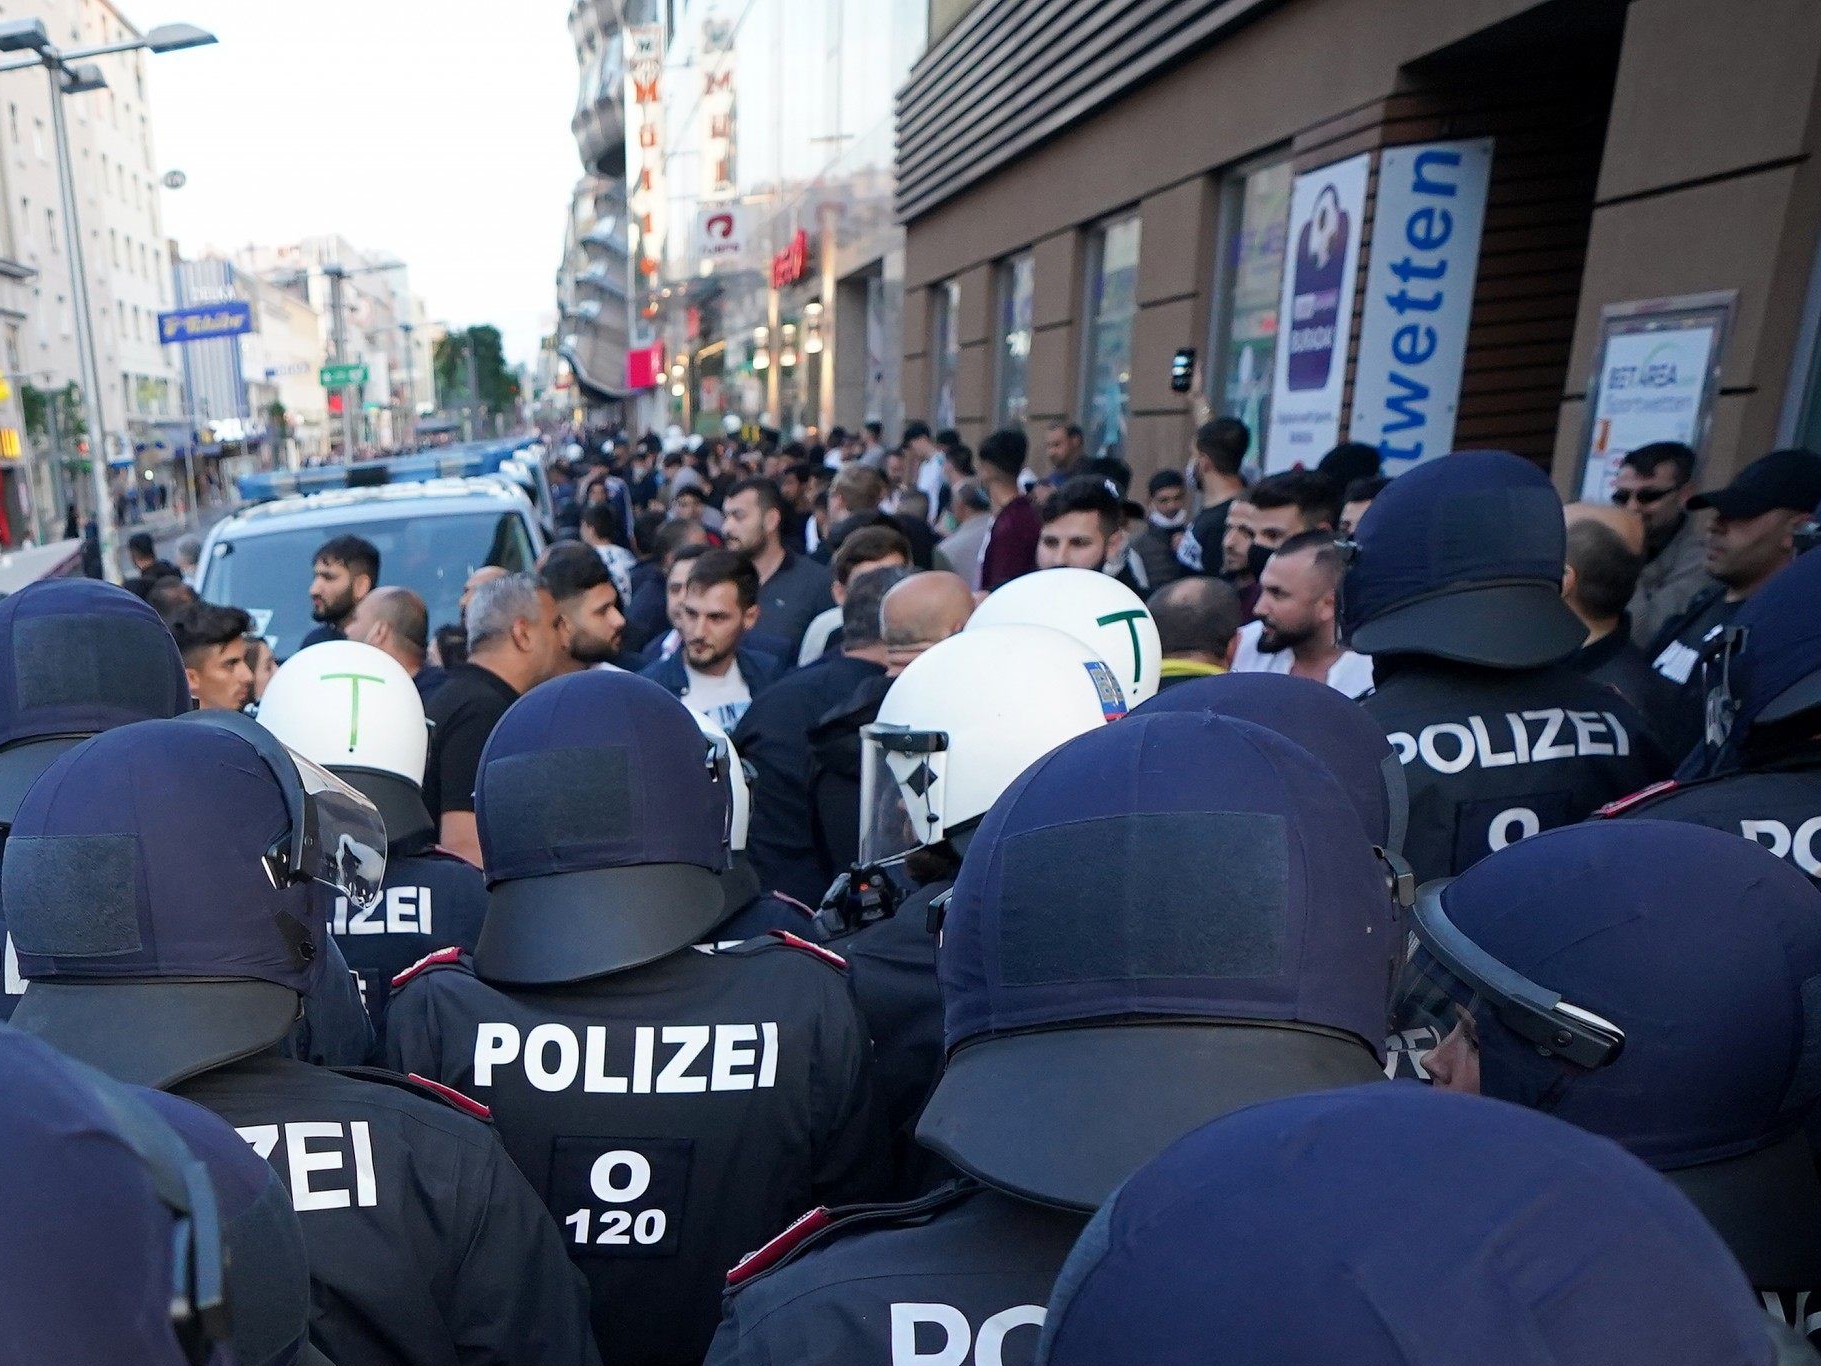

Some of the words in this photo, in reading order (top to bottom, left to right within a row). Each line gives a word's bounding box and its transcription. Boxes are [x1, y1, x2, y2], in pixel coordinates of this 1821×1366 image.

[1096, 610, 1148, 683] T
[320, 672, 386, 746] T
[1386, 707, 1630, 775] POLIZEI
[326, 886, 432, 935] IZEI
[474, 1022, 779, 1093] POLIZEI
[565, 1208, 667, 1245] 120
